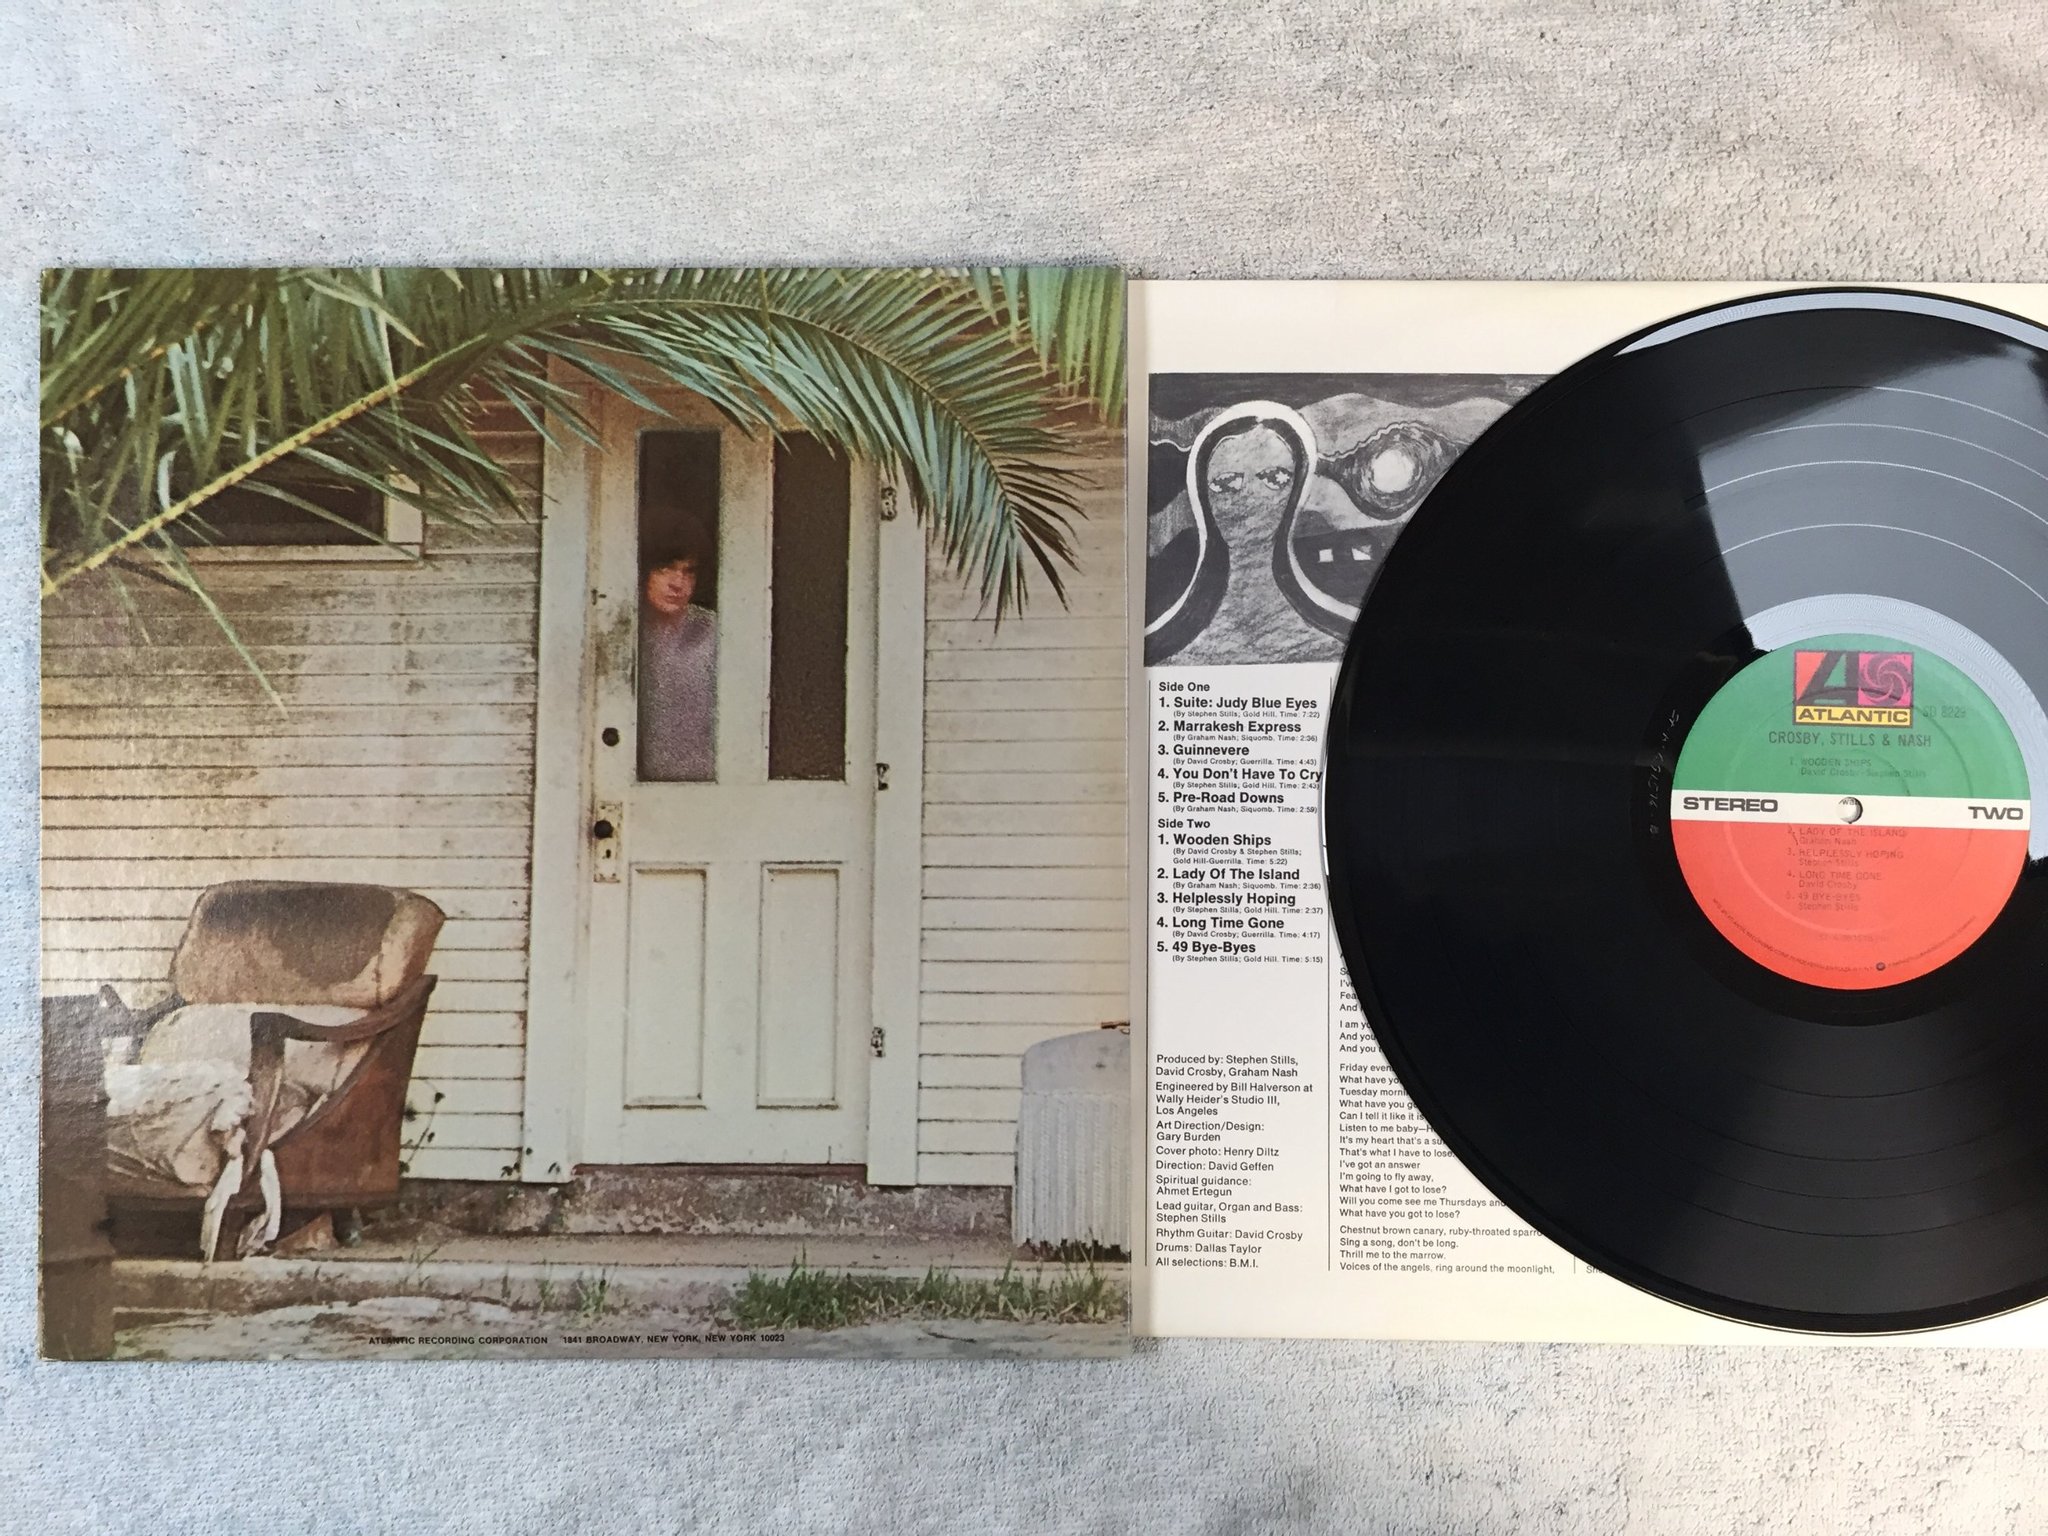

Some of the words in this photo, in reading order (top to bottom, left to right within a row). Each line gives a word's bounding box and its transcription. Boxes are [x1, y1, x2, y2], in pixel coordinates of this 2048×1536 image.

[1159, 682, 1184, 692] Side
[1188, 682, 1210, 692] One
[1159, 697, 1170, 708] 1.
[1174, 696, 1213, 708] Suite:
[1216, 697, 1248, 711] Judy
[1252, 697, 1282, 709] Blue
[1286, 698, 1317, 711] Eyes
[1798, 709, 1908, 723] ATLANTIC
[1158, 720, 1169, 732] 2.
[1174, 720, 1244, 732] Marrakesh
[1248, 721, 1302, 734] Express
[1769, 732, 1825, 747] CROSBY,
[1830, 732, 1875, 746] STILLS
[1881, 734, 1891, 746] &
[1898, 735, 1931, 747] NASH
[1158, 744, 1169, 756] 3.
[1174, 744, 1250, 756] Guinnevere
[1158, 768, 1169, 779] 4.
[1173, 768, 1199, 780] You
[1203, 768, 1238, 779] Don't
[1242, 768, 1275, 780] Have
[1279, 769, 1296, 780] To
[1300, 768, 1322, 783] Cry
[1158, 792, 1169, 803] 5.
[1174, 792, 1235, 803] Pre-Road
[1240, 792, 1284, 804] Downs
[1683, 797, 1779, 813] STEREO
[1968, 806, 2023, 821] TWO
[1158, 818, 1184, 828] Side
[1187, 819, 1211, 829] Two
[1158, 834, 1169, 845] 1.
[1173, 834, 1229, 845] Wooden
[1233, 834, 1272, 848] Ships
[1173, 848, 1186, 856] (By
[1211, 848, 1238, 856] Crosby
[1247, 848, 1278, 856] Stephen
[1270, 858, 1288, 866] 5:22)
[1157, 868, 1169, 879] 2.
[1173, 868, 1206, 882] Lady
[1210, 868, 1226, 880] Of
[1230, 868, 1255, 880] The
[1259, 868, 1300, 880] Island
[1157, 892, 1168, 904] 3.
[1173, 892, 1243, 907] Helplessly
[1247, 893, 1296, 907] Hoping
[1157, 916, 1168, 928] 4.
[1173, 916, 1206, 931] Long
[1210, 917, 1244, 928] Time
[1248, 917, 1284, 929] Gone
[1157, 941, 1168, 952] 5.
[1172, 941, 1188, 953] 49
[1192, 941, 1256, 955] Bye-Byes
[1157, 1054, 1206, 1064] Produced
[1208, 1054, 1223, 1066] by:
[1226, 1055, 1268, 1066] Stephen
[1270, 1055, 1298, 1066] Stills,
[1156, 1067, 1185, 1076] David
[1187, 1067, 1226, 1078] Crosby,
[1229, 1068, 1269, 1077] Graham
[1272, 1068, 1298, 1077] Nash
[1156, 1082, 1214, 1093] Engineered
[1216, 1082, 1229, 1093] by
[1231, 1082, 1247, 1092] Bill
[1250, 1083, 1301, 1092] Halverson
[1303, 1084, 1313, 1092] at
[1156, 1094, 1184, 1106] Wally
[1187, 1094, 1229, 1104] Heider's
[1231, 1095, 1264, 1105] Studio
[1268, 1096, 1280, 1106] III,
[1156, 1106, 1175, 1115] Los
[1177, 1106, 1218, 1117] Angeles
[1156, 1120, 1172, 1130] Art
[1174, 1120, 1264, 1132] Direction/Design:
[1156, 1132, 1182, 1143] Gary
[1184, 1132, 1221, 1142] Burden
[1156, 1146, 1187, 1155] Cover
[1189, 1146, 1221, 1157] photo:
[1224, 1147, 1254, 1158] Henry
[1257, 1147, 1279, 1157] Diltz
[1156, 1160, 1206, 1170] Direction:
[1209, 1161, 1238, 1171] David
[1240, 1162, 1274, 1171] Geffen
[1156, 1176, 1199, 1187] Spiritual
[1201, 1176, 1251, 1187] guidance:
[1156, 1187, 1190, 1196] Ahmet
[1192, 1187, 1232, 1198] Ertegun
[1340, 1184, 1363, 1193] What
[1365, 1184, 1387, 1193] have
[1390, 1185, 1392, 1193] I
[1394, 1186, 1409, 1195] got
[1411, 1186, 1420, 1194] to
[1423, 1186, 1447, 1194] lose?
[1156, 1201, 1182, 1211] Lead
[1184, 1202, 1216, 1212] guitar,
[1219, 1202, 1251, 1213] Organ
[1253, 1203, 1272, 1212] and
[1275, 1203, 1302, 1212] Bass:
[1156, 1213, 1198, 1224] Stephen
[1201, 1214, 1226, 1223] Stills
[1156, 1228, 1195, 1239] Rhythm
[1197, 1229, 1232, 1238] Guitar:
[1235, 1230, 1264, 1239] David
[1266, 1230, 1303, 1240] Crosby
[1156, 1243, 1192, 1253] Drums:
[1196, 1243, 1227, 1253] Dallas
[1229, 1244, 1262, 1254] Taylor
[1340, 1238, 1360, 1248] Sing
[1370, 1240, 1395, 1249] song,
[1398, 1238, 1421, 1247] don't
[1423, 1239, 1434, 1247] be
[1437, 1239, 1459, 1250] long.
[1156, 1258, 1169, 1266] All
[1172, 1258, 1227, 1268] selections:
[1230, 1258, 1258, 1268] B.M.I.
[1340, 1262, 1371, 1271] Voices
[1373, 1262, 1382, 1271] of
[1384, 1263, 1399, 1271] the
[1400, 1264, 1432, 1274] angels,
[1436, 1264, 1453, 1274] ring
[1456, 1264, 1488, 1272] around
[1490, 1264, 1505, 1273] the
[1507, 1265, 1555, 1275] moonlight,
[369, 1337, 415, 1345] ATLANTIC
[418, 1337, 475, 1345] RECORDING
[478, 1336, 548, 1345] CORPORATION
[563, 1335, 583, 1344] 1841
[586, 1335, 644, 1344] BROADWAY,
[647, 1334, 669, 1343] NEW
[672, 1334, 701, 1343] YORK,
[705, 1334, 727, 1343] NEW
[730, 1334, 757, 1343] YORK
[760, 1334, 786, 1343] 10023
